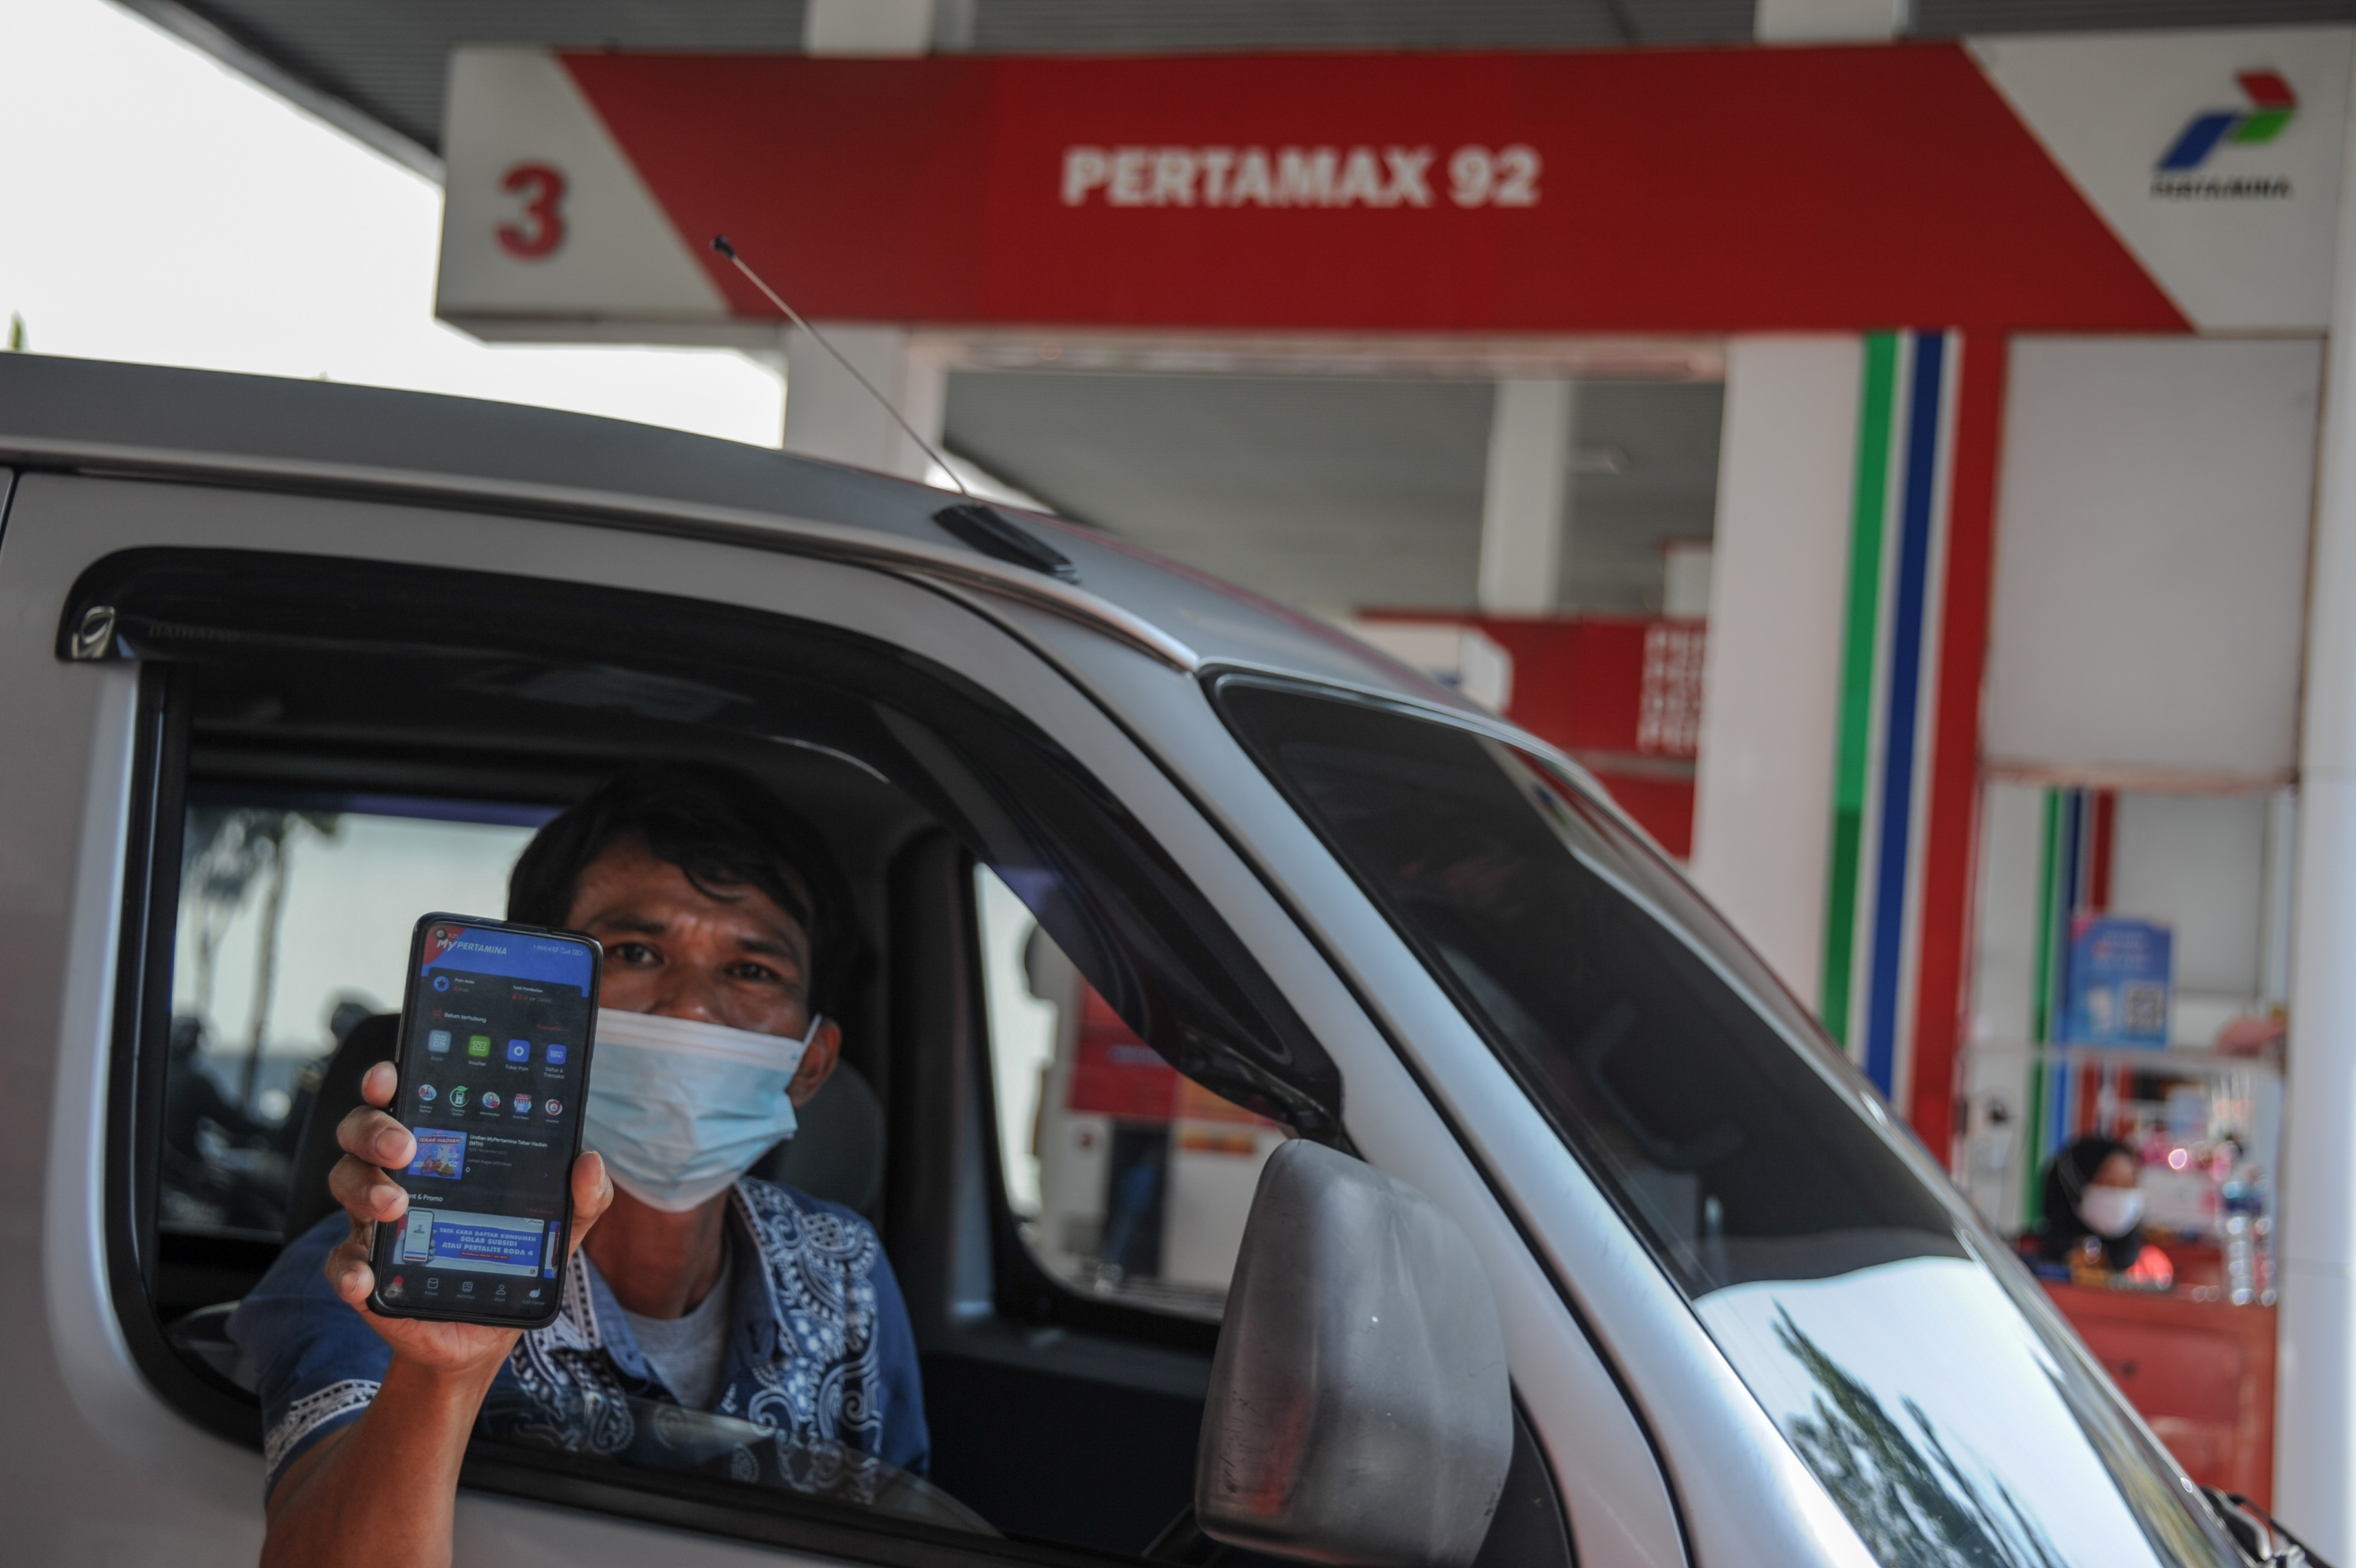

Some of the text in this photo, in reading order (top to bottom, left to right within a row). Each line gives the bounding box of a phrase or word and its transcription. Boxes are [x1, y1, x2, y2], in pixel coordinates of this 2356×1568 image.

[1062, 143, 1541, 209] PERTAMAX 92
[494, 159, 568, 263] 3
[461, 1014, 487, 1023] terhubung
[423, 1194, 444, 1202] Promo
[461, 1236, 518, 1247] SOLAR SUBSIDI
[500, 1233, 537, 1242] KONSUMEN
[464, 1244, 502, 1253] PERTALITE
